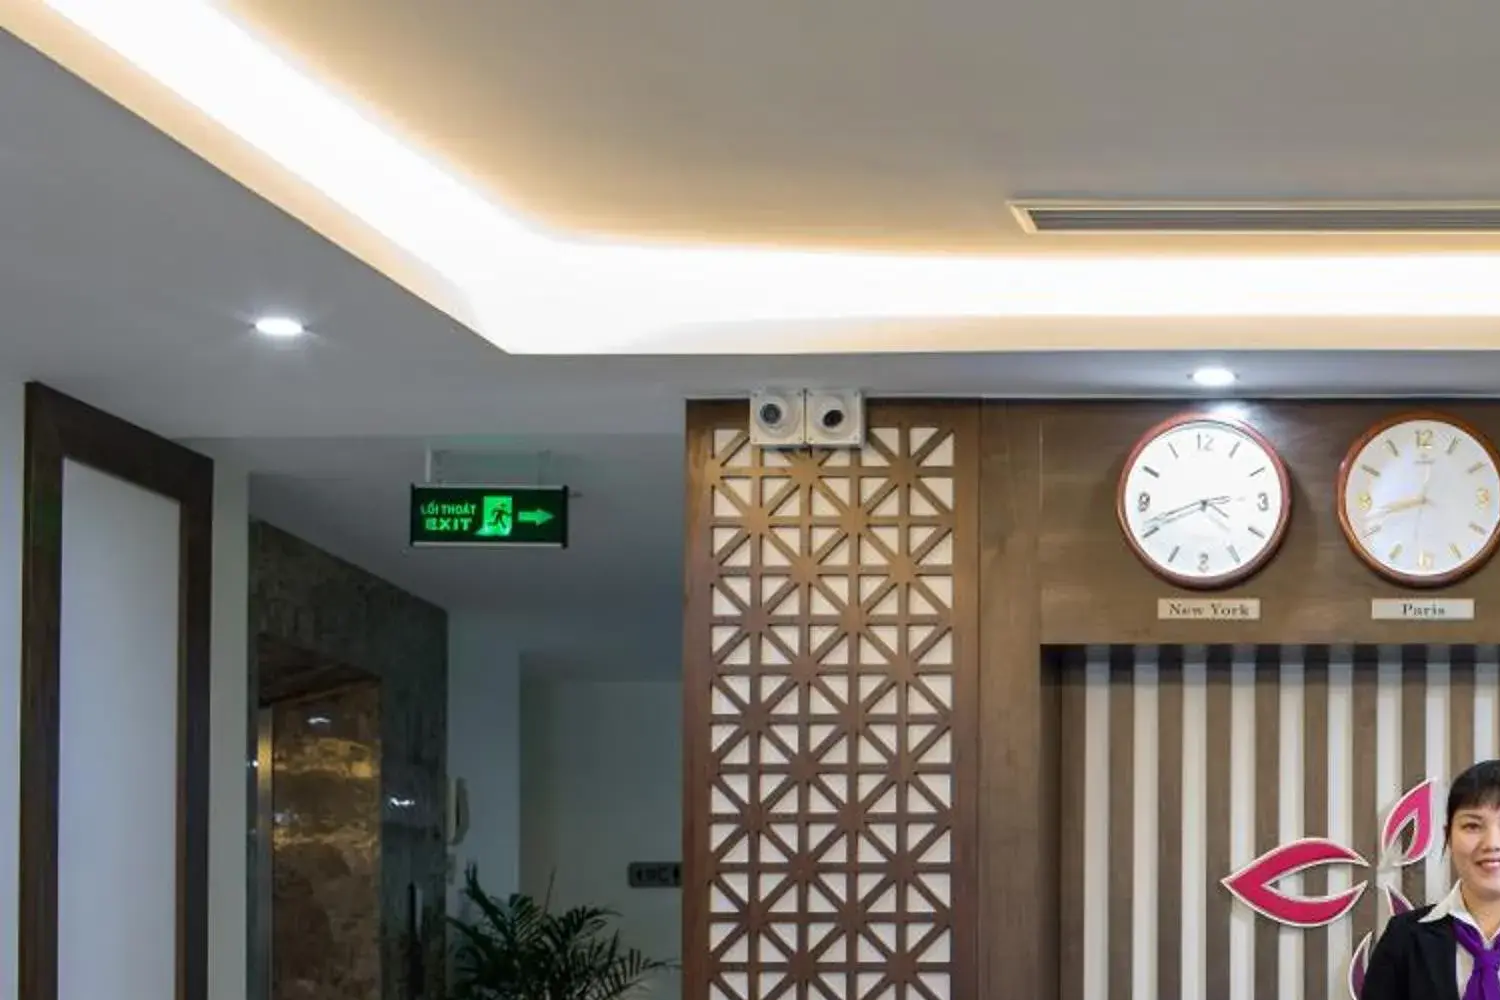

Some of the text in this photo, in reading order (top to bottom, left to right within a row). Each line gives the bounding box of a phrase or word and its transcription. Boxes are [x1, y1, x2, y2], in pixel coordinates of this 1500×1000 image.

[1197, 432, 1215, 451] 12
[1415, 430, 1433, 449] 12
[1257, 492, 1269, 512] 3
[425, 517, 473, 531] EXIT
[1169, 602, 1250, 616] New York
[1402, 602, 1446, 616] Paris
